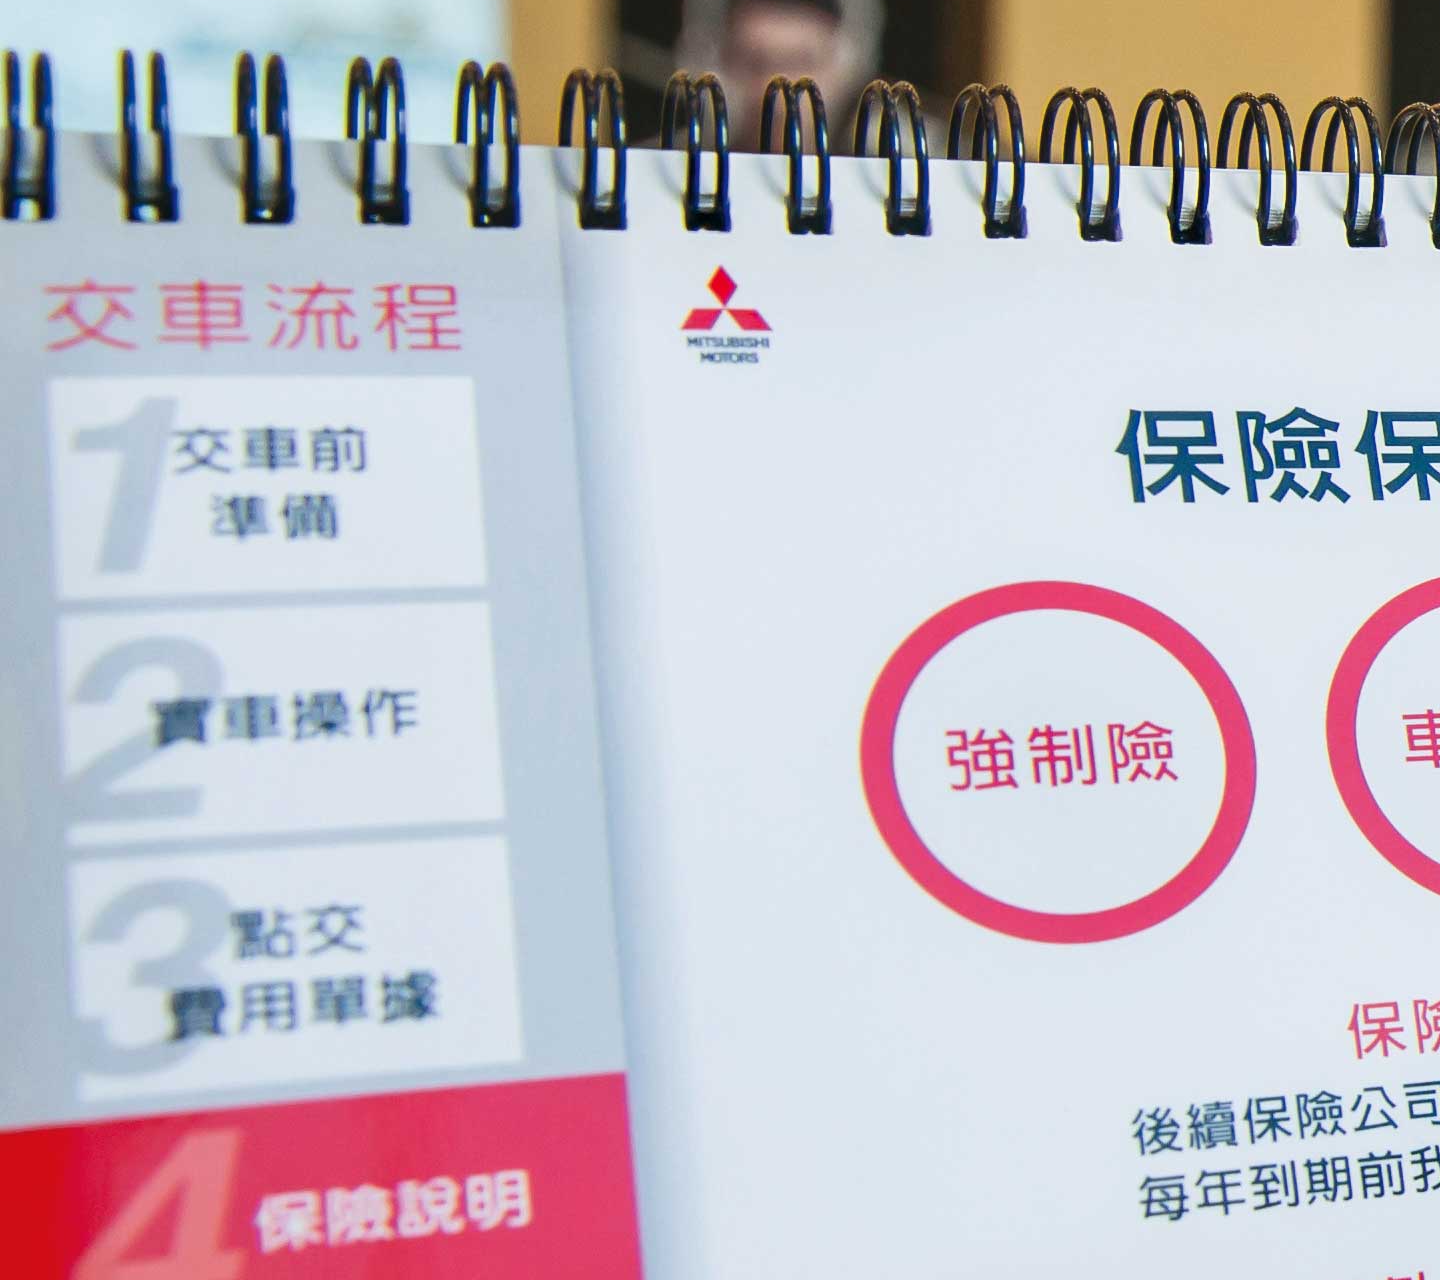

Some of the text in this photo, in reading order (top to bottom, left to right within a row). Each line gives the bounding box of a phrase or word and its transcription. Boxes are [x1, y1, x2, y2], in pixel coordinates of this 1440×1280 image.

[43, 279, 463, 353] 交車流程
[686, 336, 770, 349] MITSUBISHI
[700, 352, 759, 364] MOTORS
[171, 426, 368, 475] 交車前
[70, 396, 180, 575] 1
[210, 494, 340, 540] 準備
[149, 688, 420, 749] 實車操作
[944, 720, 1180, 793] 強制險
[228, 904, 367, 960] 點交
[166, 968, 444, 1043] 費用單據
[254, 1169, 534, 1253] 保險說明
